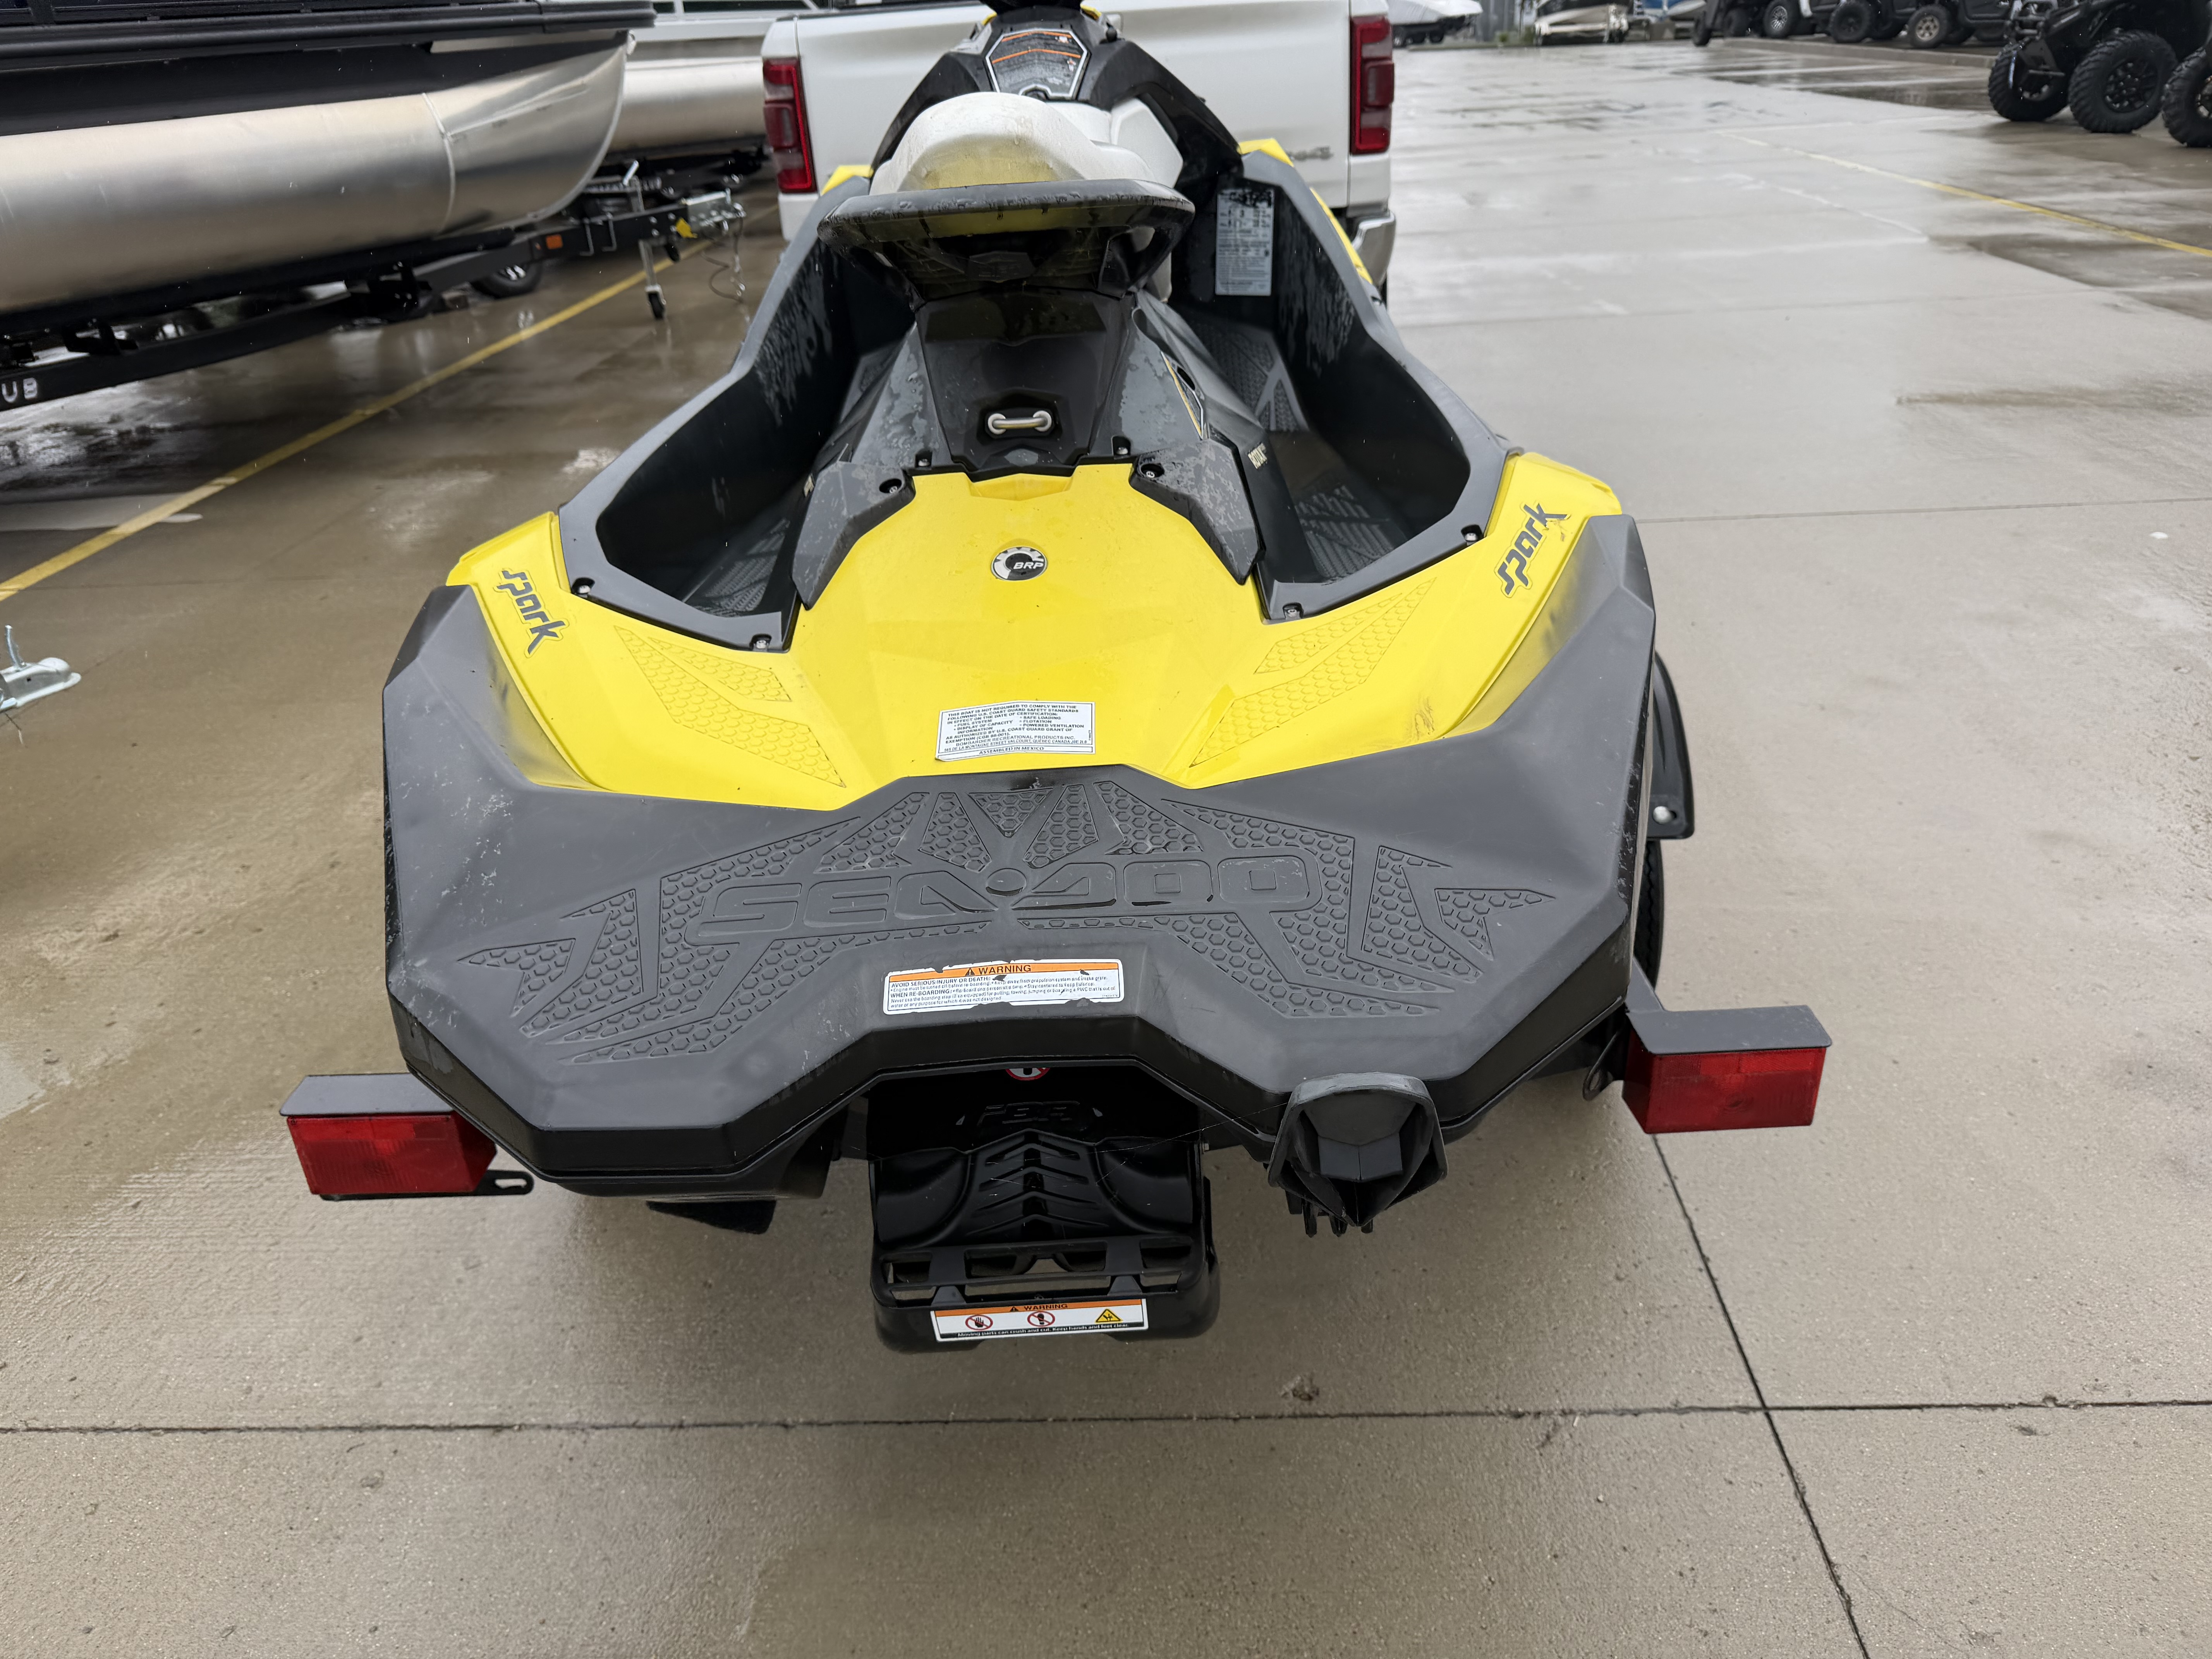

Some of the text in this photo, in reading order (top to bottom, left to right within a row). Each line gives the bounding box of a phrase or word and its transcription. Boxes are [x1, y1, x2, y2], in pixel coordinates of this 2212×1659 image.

[1498, 503, 1567, 595] spark
[496, 570, 565, 654] spark
[979, 965, 1031, 974] WARNING
